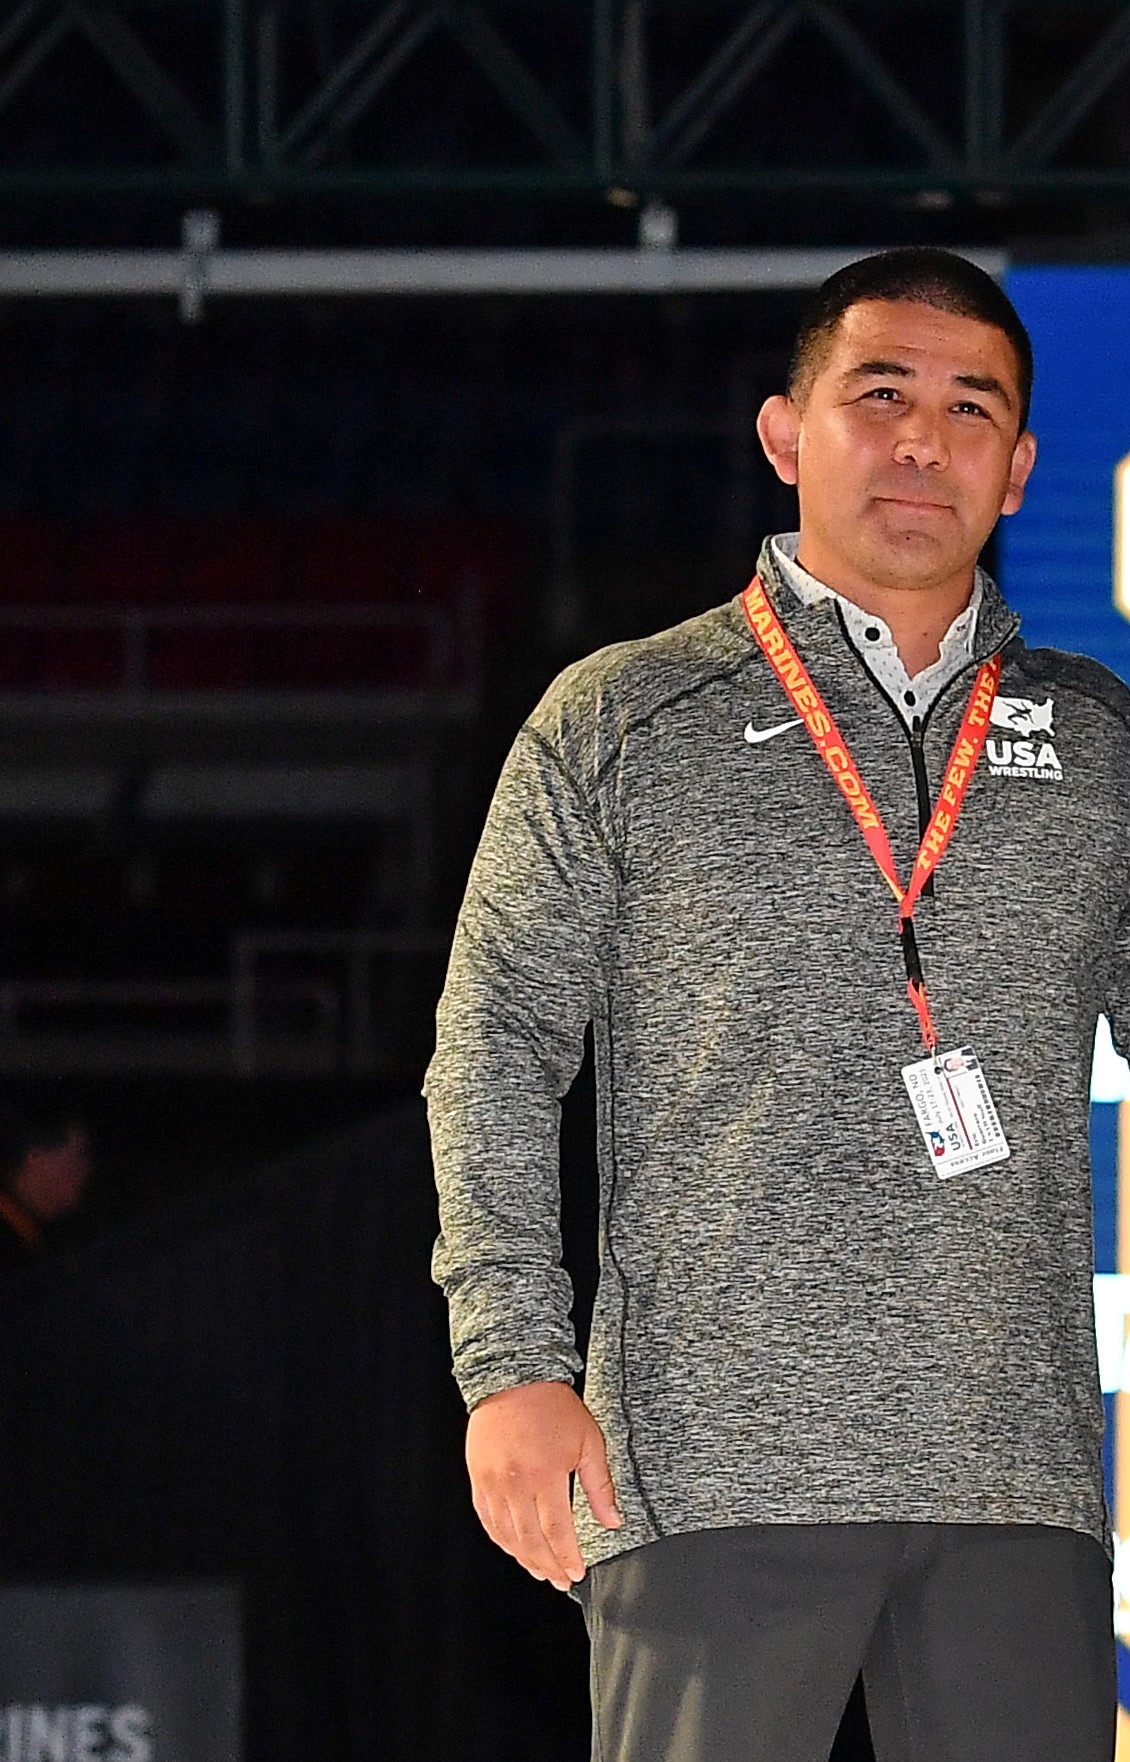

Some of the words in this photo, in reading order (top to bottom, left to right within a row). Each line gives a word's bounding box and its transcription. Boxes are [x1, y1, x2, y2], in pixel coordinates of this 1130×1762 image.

[745, 584, 880, 830] MARINES.COM
[986, 739, 1063, 770] USA
[916, 811, 951, 870] THE
[942, 738, 979, 808] FEW.
[968, 672, 996, 727] THE
[988, 765, 1064, 780] WRESTLING
[909, 1073, 920, 1089] ND
[946, 1123, 961, 1151] USA
[0, 1703, 151, 1762] INES
